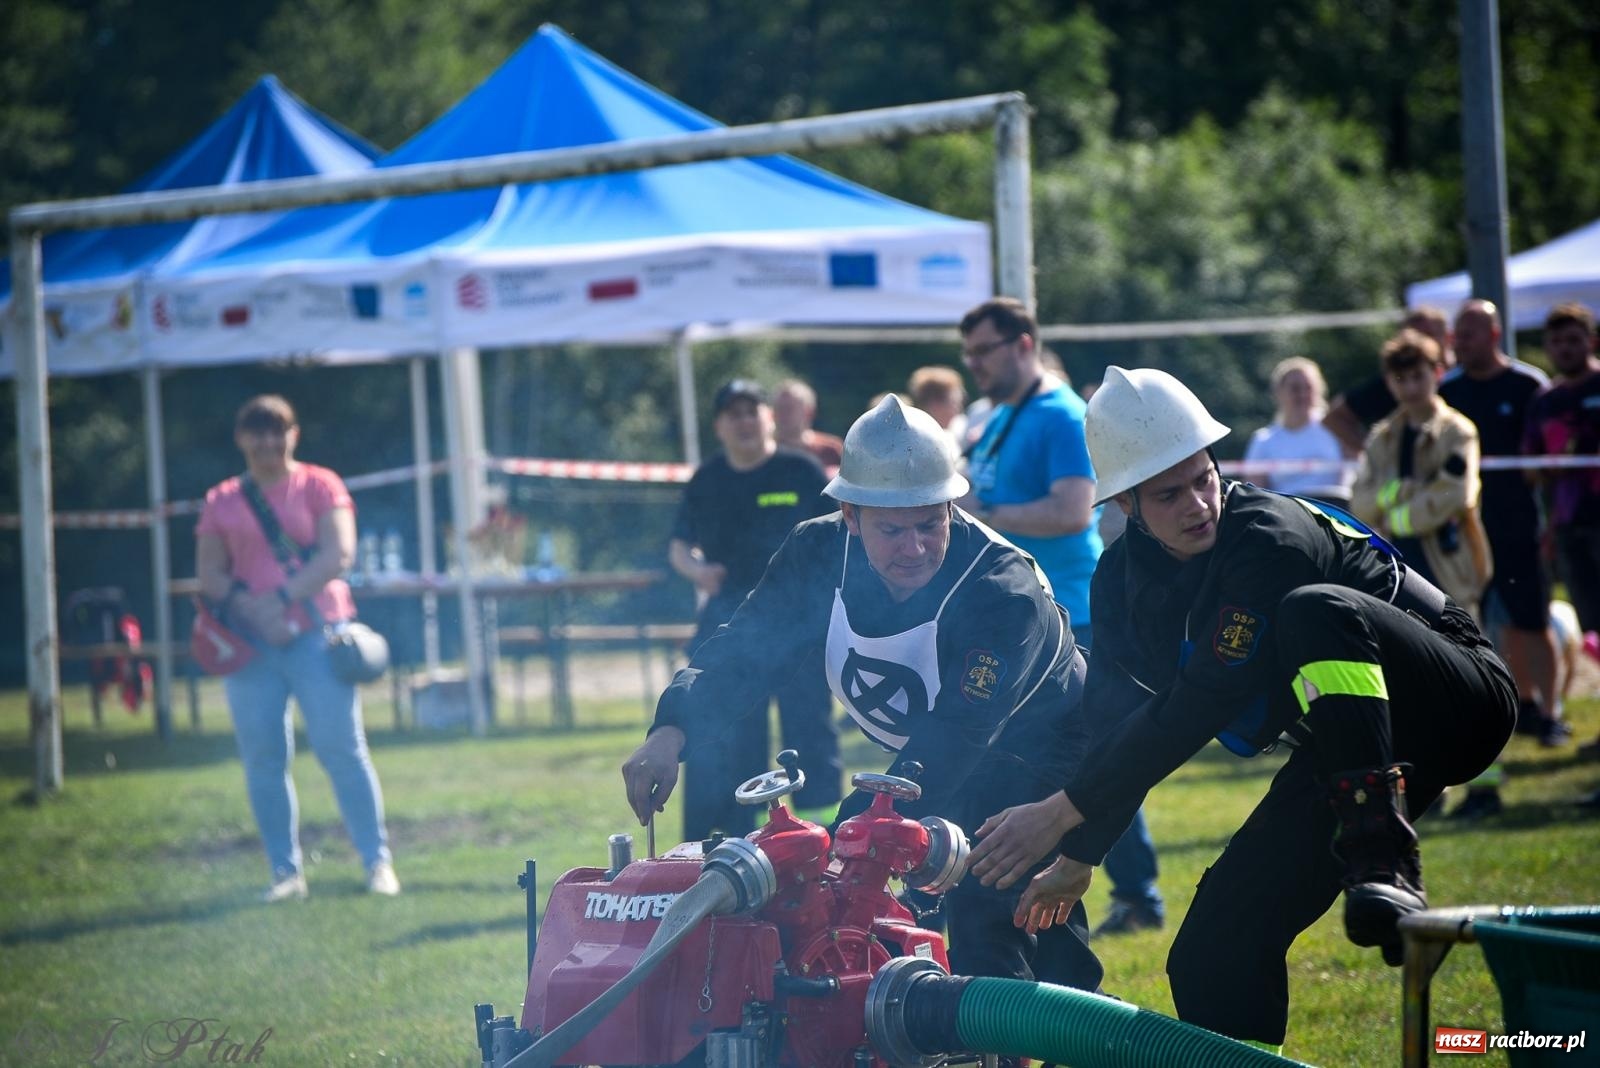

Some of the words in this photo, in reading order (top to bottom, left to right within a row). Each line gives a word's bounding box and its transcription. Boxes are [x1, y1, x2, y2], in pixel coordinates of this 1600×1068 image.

[1232, 612, 1256, 625] OSP
[978, 654, 999, 666] OSP
[585, 892, 685, 921] TOHATS
